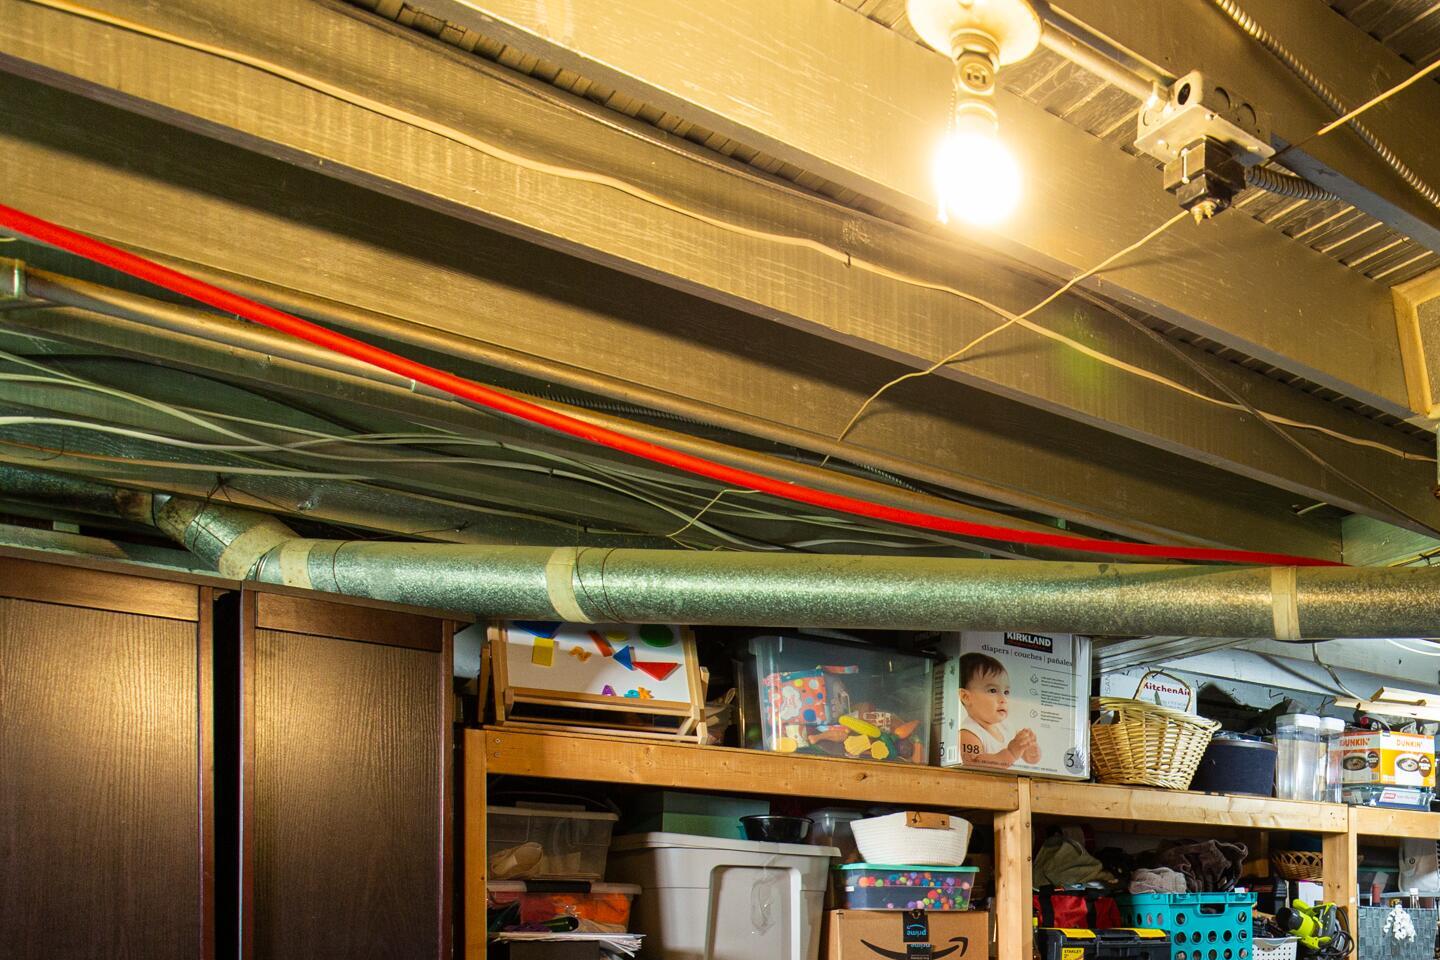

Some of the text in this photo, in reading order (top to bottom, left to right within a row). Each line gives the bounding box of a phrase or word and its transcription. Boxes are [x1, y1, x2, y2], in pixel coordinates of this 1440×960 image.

[1006, 631, 1052, 647] KIRKLAND
[982, 644, 1009, 655] diapers
[1014, 651, 1042, 661] couches
[962, 743, 980, 754] 198
[1066, 753, 1075, 767] 3
